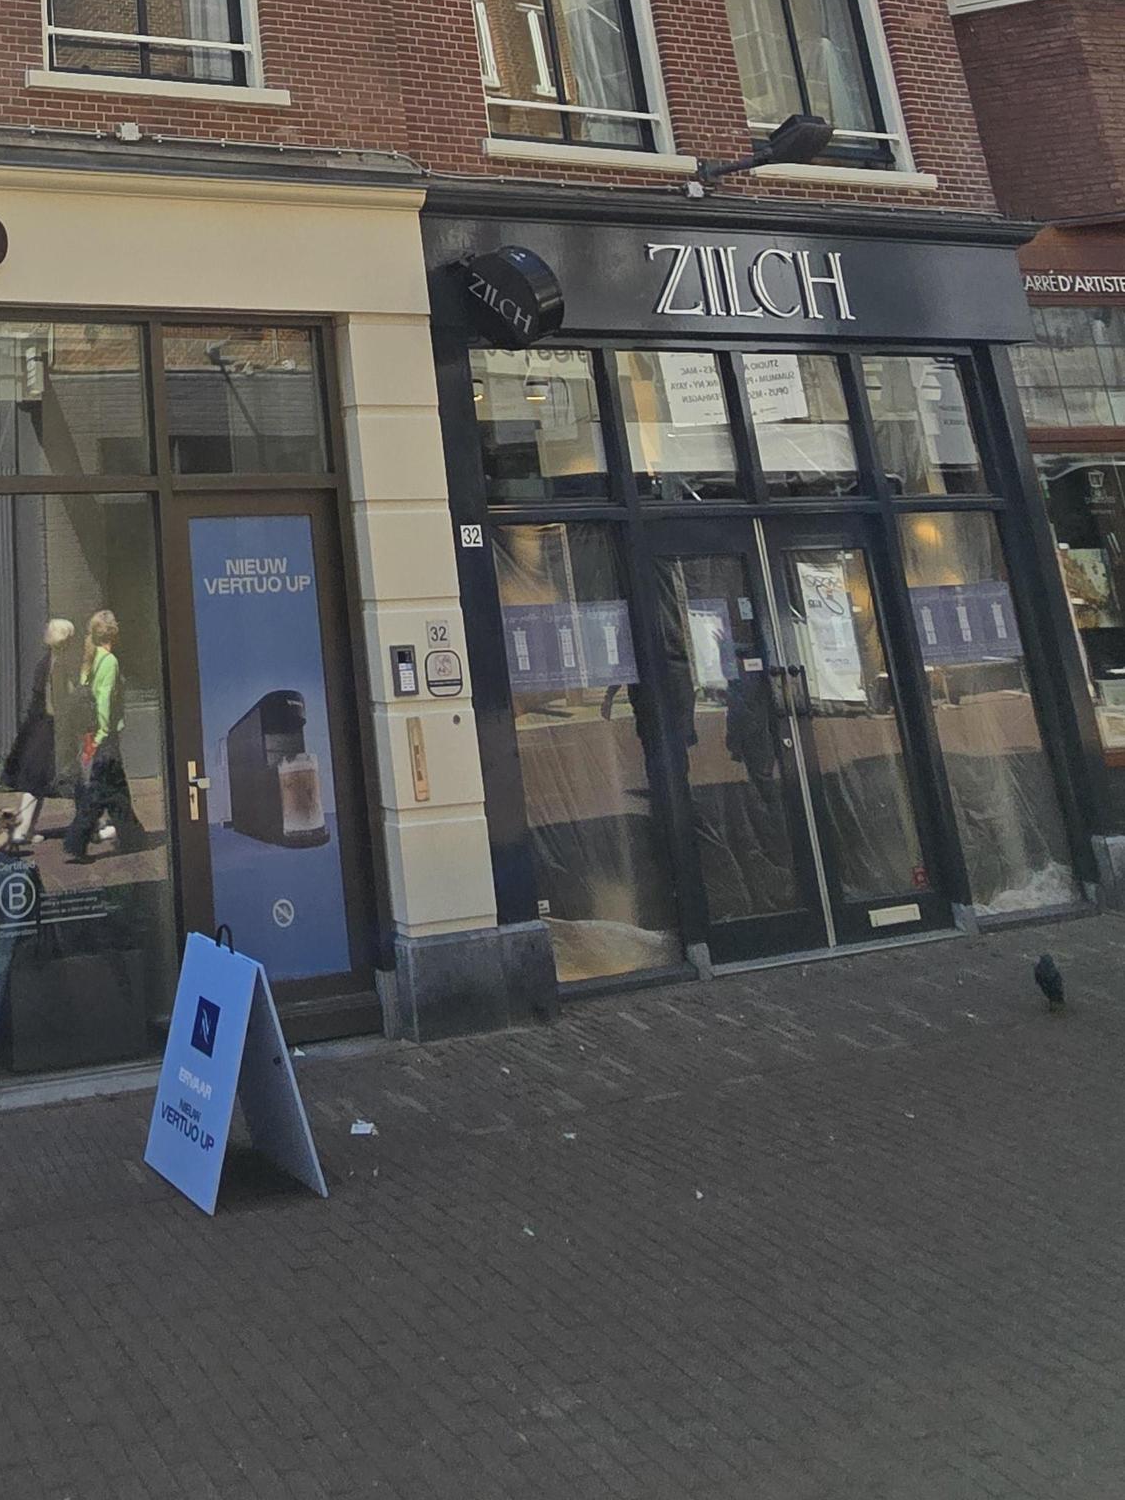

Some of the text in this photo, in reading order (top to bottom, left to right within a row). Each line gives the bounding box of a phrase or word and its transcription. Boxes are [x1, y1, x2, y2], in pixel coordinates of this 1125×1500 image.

[646, 243, 856, 321] ZILCH
[468, 272, 533, 335] ZILCH
[462, 527, 481, 546] 32
[226, 557, 287, 576] NIEUW
[204, 574, 311, 596] VERTUO UP
[430, 626, 448, 641] 32
[8, 882, 27, 910] B
[161, 1101, 215, 1152] VERTUO UP
